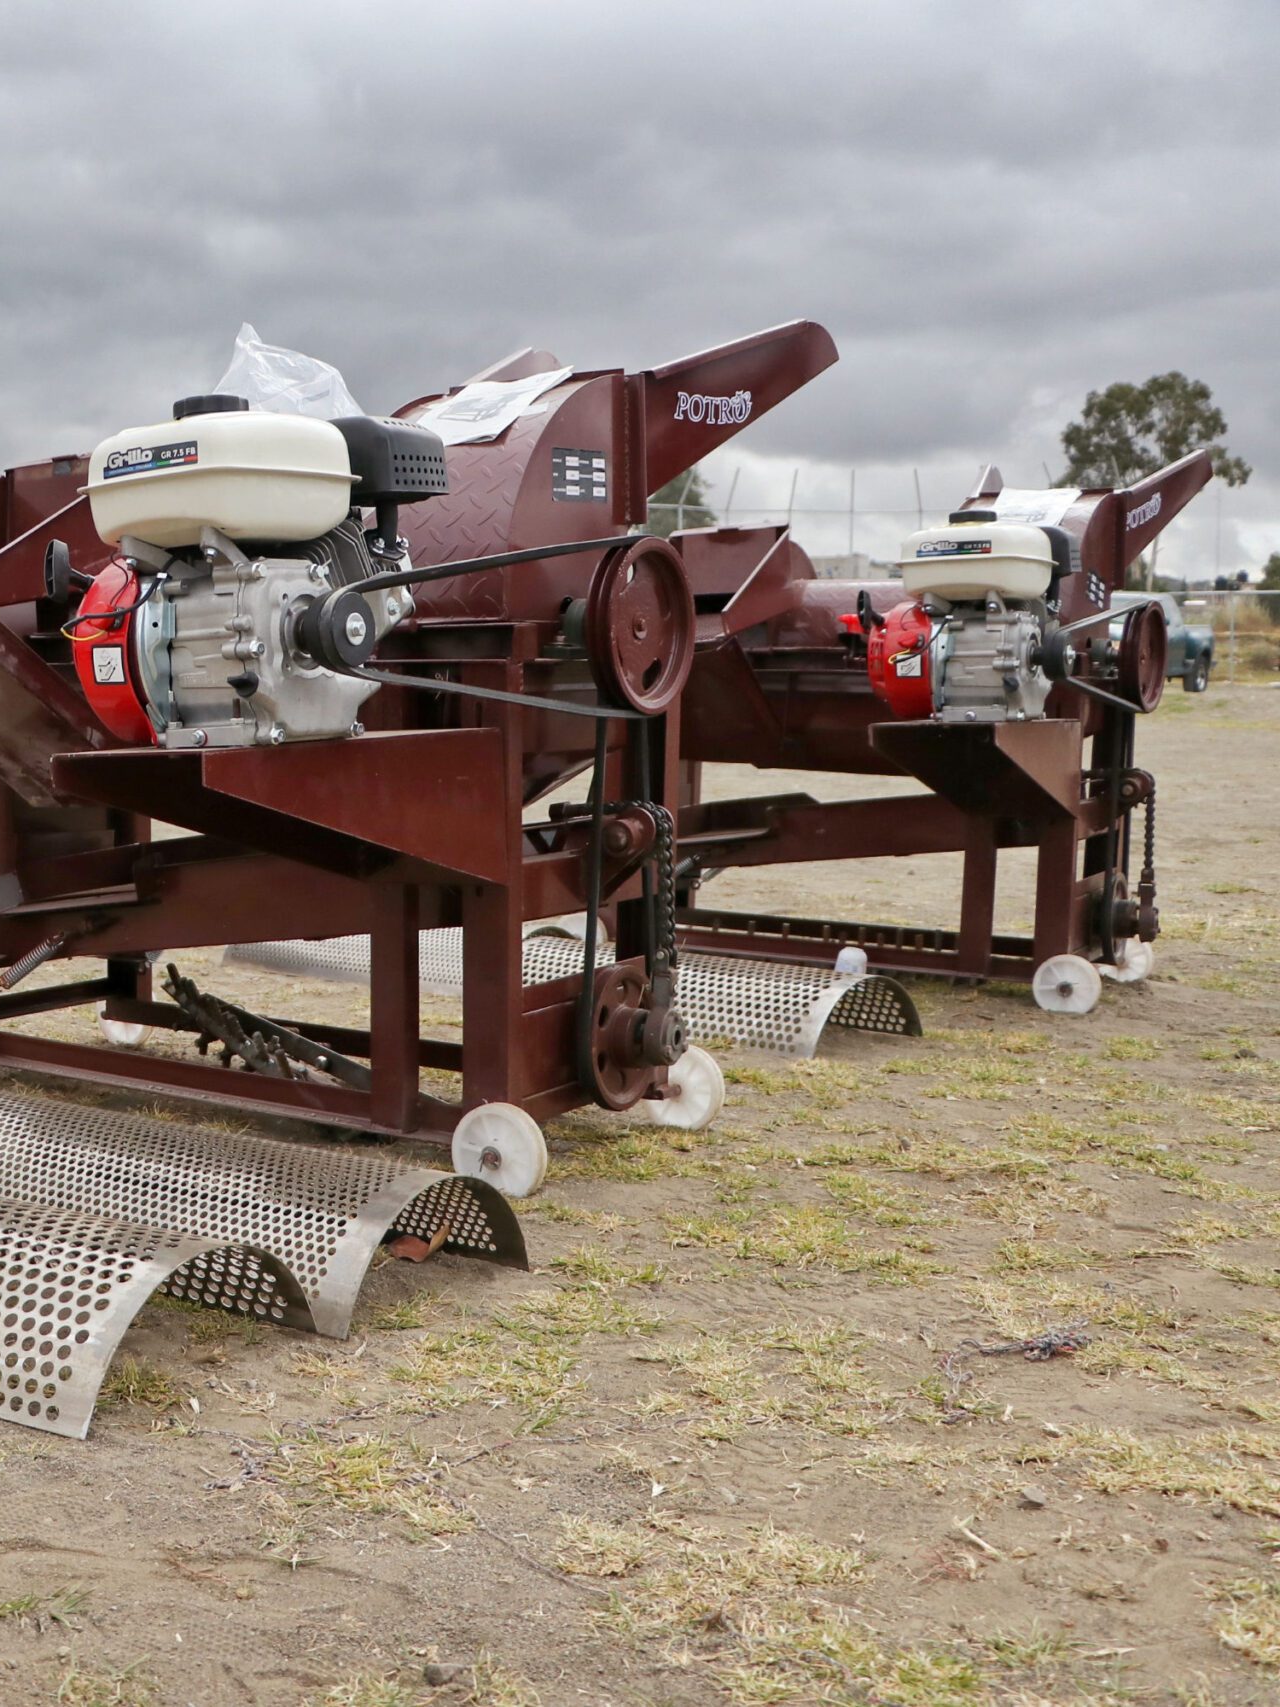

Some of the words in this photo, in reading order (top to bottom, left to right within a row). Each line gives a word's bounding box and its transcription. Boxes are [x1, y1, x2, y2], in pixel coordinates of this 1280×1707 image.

[674, 391, 753, 425] POTRO
[108, 448, 153, 469] Grillo
[161, 451, 172, 460] GR
[173, 448, 185, 458] 7.5
[186, 446, 197, 455] FB
[920, 540, 958, 552] Grillo
